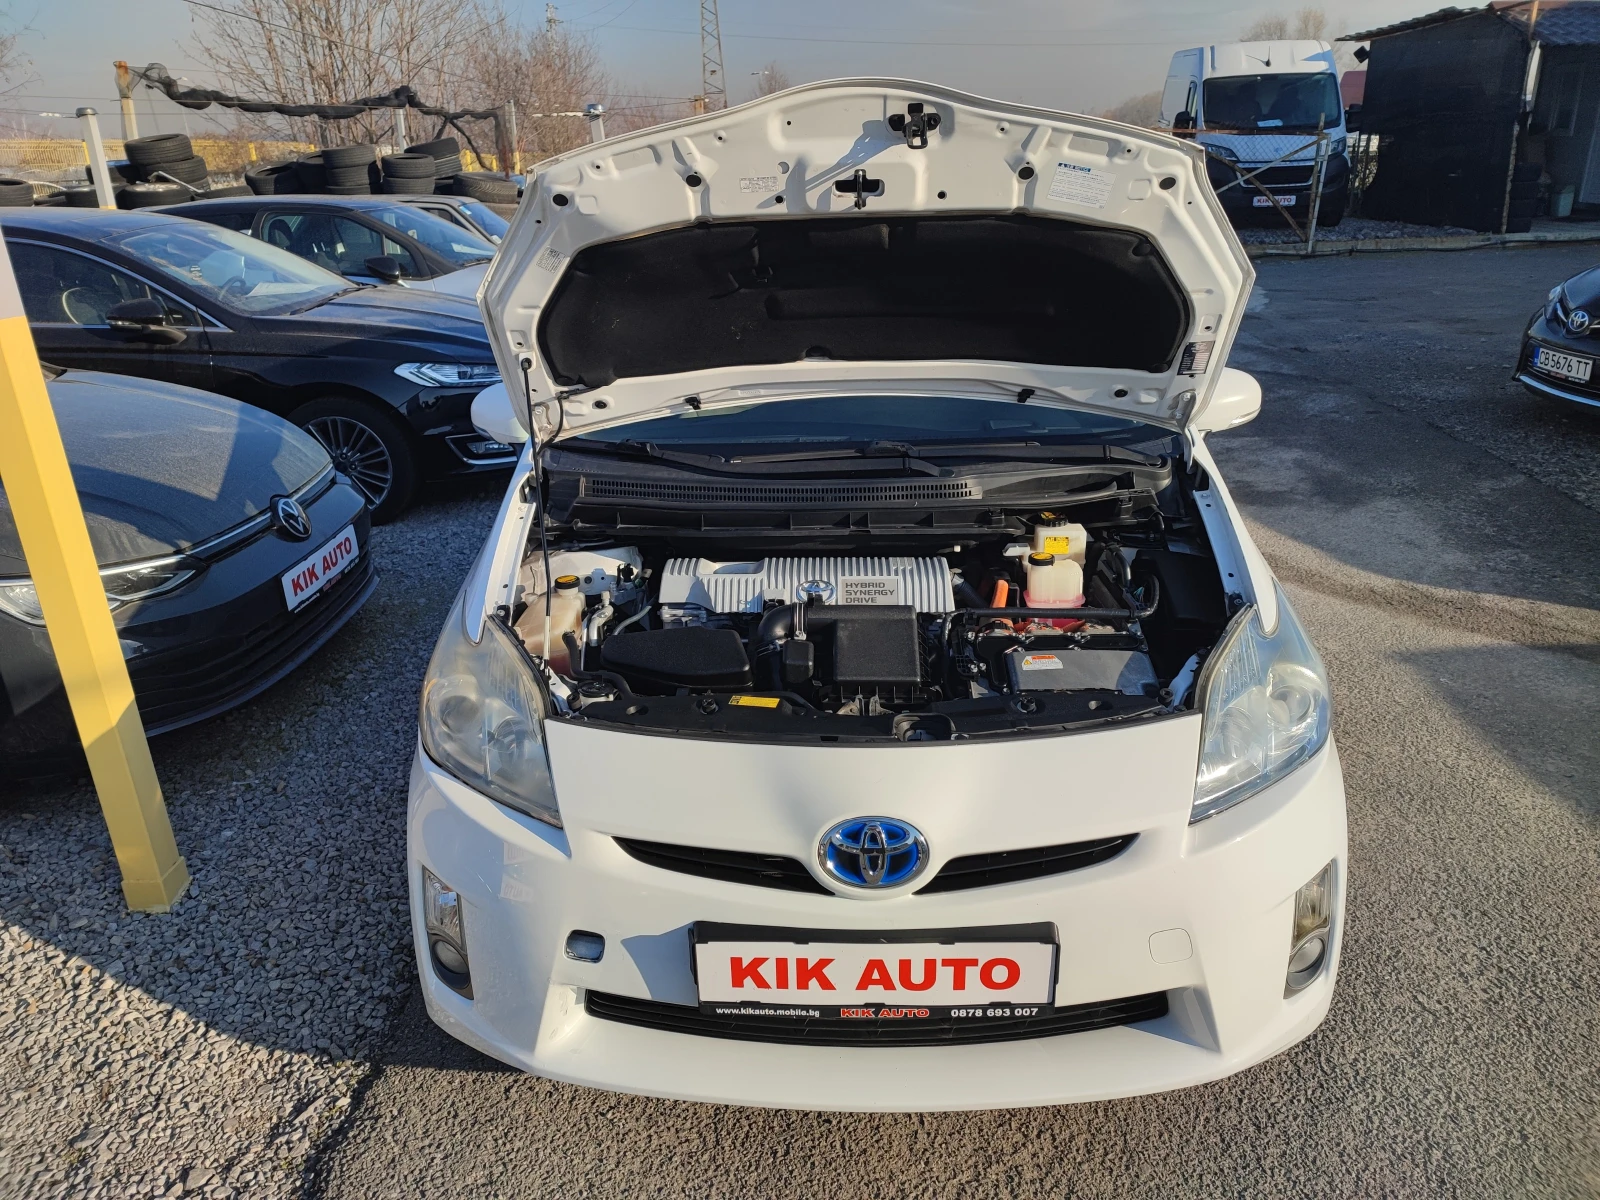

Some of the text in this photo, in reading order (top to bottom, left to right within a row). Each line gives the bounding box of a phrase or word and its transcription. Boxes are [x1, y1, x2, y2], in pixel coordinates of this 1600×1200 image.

[1550, 354, 1573, 373] 5676
[1576, 360, 1590, 377] TT
[291, 563, 320, 597] KIK
[322, 536, 352, 576] AUTO
[845, 596, 878, 604] DRIVE
[730, 956, 1021, 992] KIK AUTO
[840, 1008, 876, 1018] KIK
[879, 1008, 930, 1018] AUTO
[950, 1008, 983, 1017] 0878
[986, 1008, 1011, 1017] 693
[1014, 1007, 1039, 1016] 007
